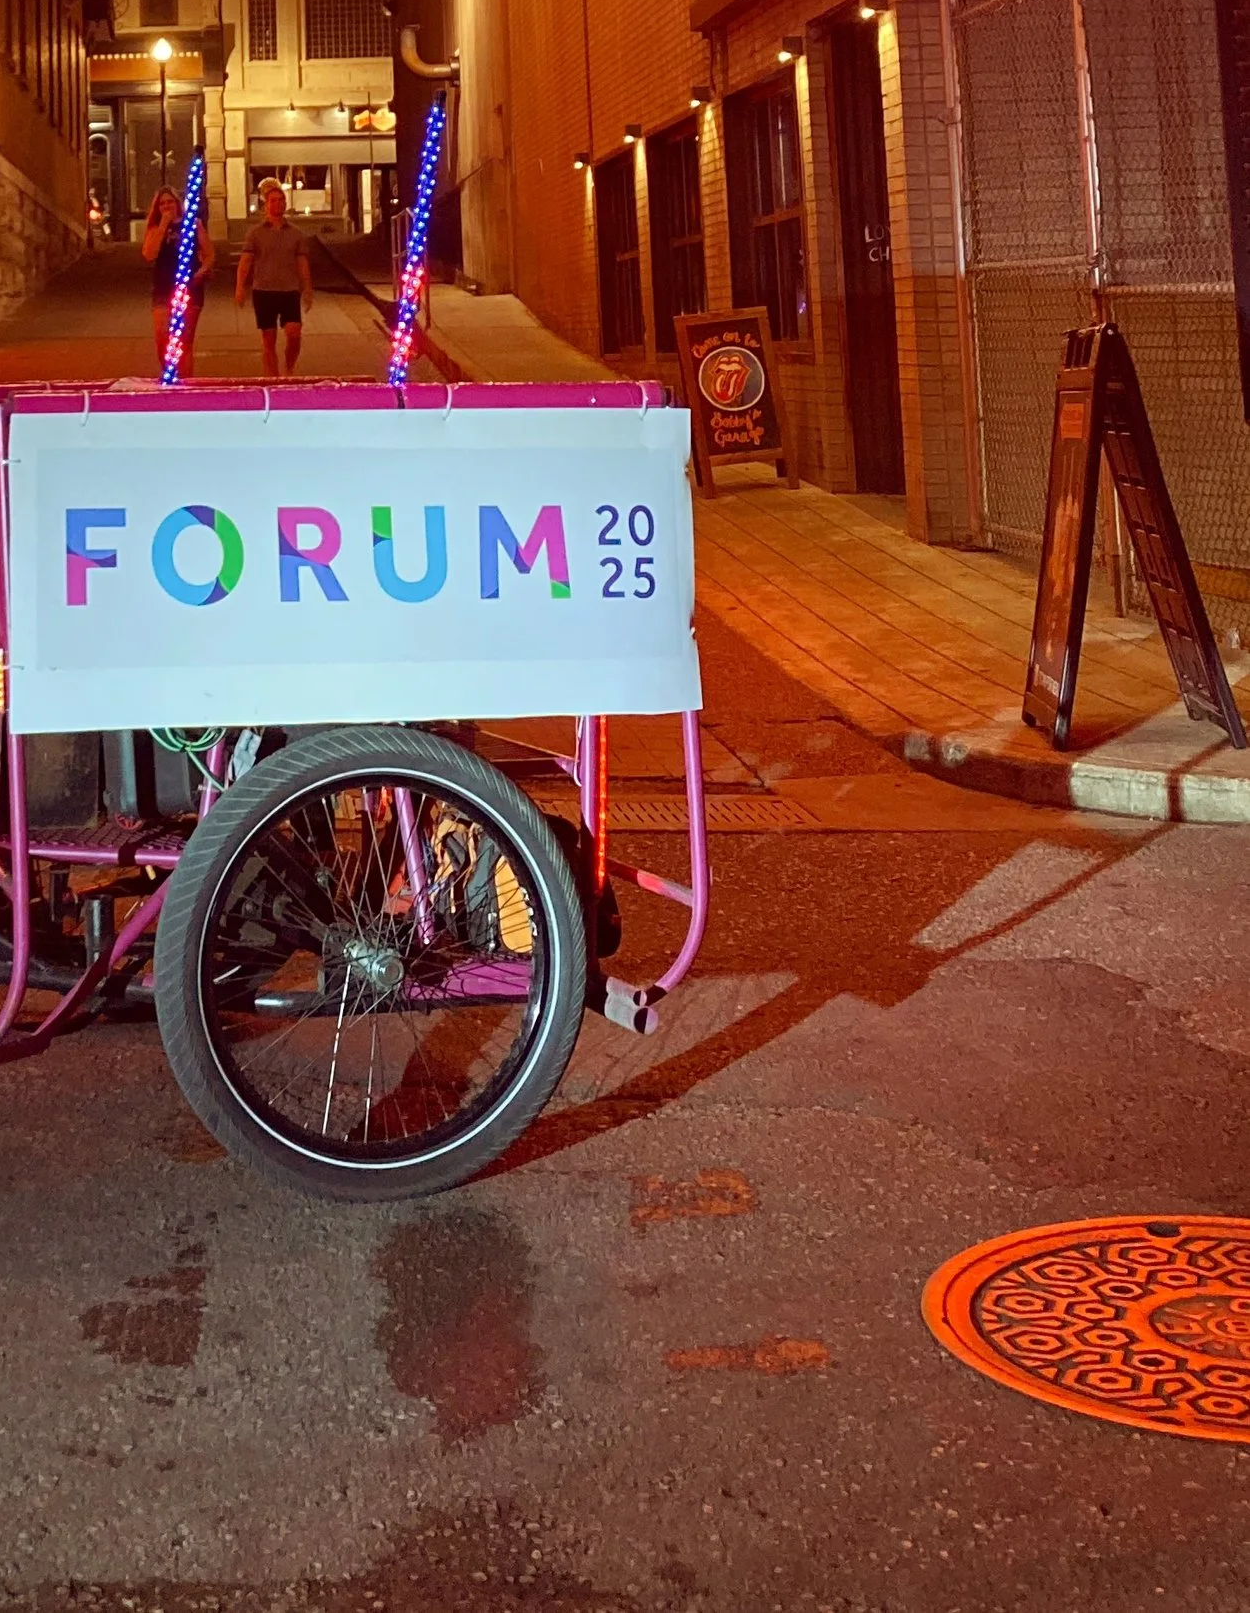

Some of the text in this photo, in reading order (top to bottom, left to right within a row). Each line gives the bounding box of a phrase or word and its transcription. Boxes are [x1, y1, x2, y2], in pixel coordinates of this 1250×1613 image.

[864, 223, 890, 243] LO
[65, 504, 655, 607] FORUM 20
[600, 556, 656, 600] 25
